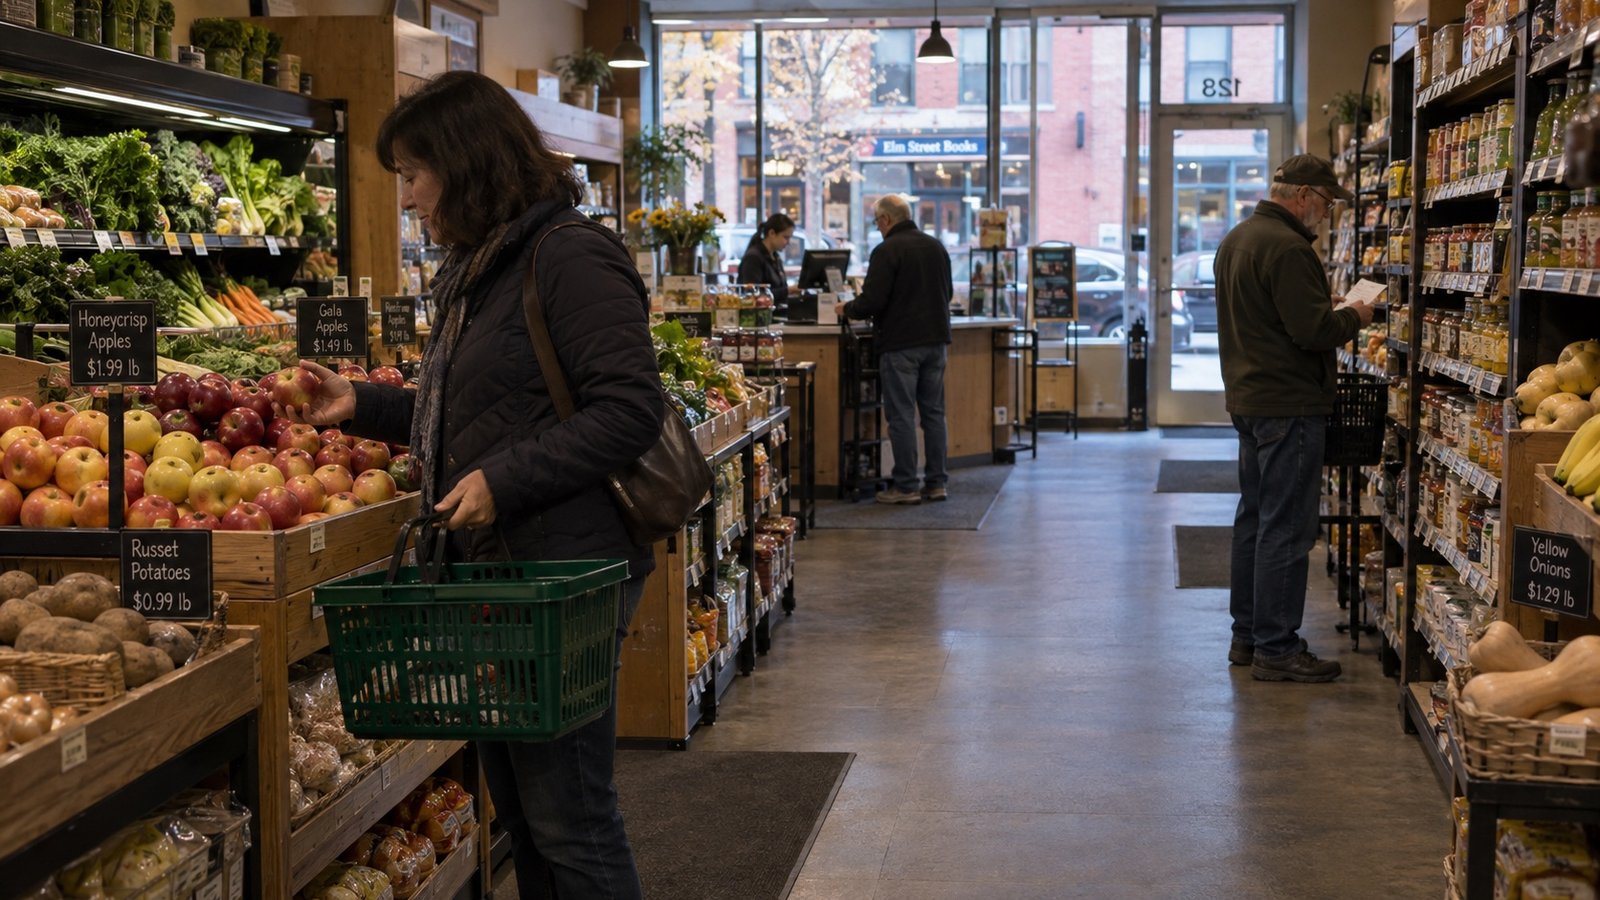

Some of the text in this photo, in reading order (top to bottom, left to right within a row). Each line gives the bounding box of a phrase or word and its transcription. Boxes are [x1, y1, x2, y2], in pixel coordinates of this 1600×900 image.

[883, 139, 978, 153] Elm Street Books
[79, 309, 147, 332] Honeycrisp
[319, 303, 343, 317] Gala
[316, 319, 348, 337] Apples
[88, 331, 131, 354] Apples
[313, 337, 353, 353] $1.49 lb
[87, 357, 140, 378] $1.99 lb
[132, 538, 178, 558] Russet
[1531, 536, 1568, 558] Yellow
[132, 562, 191, 581] Potatoes
[1530, 556, 1571, 579] Onions
[132, 590, 191, 611] $0.99 lb
[1528, 580, 1575, 608] $1.29 lb
